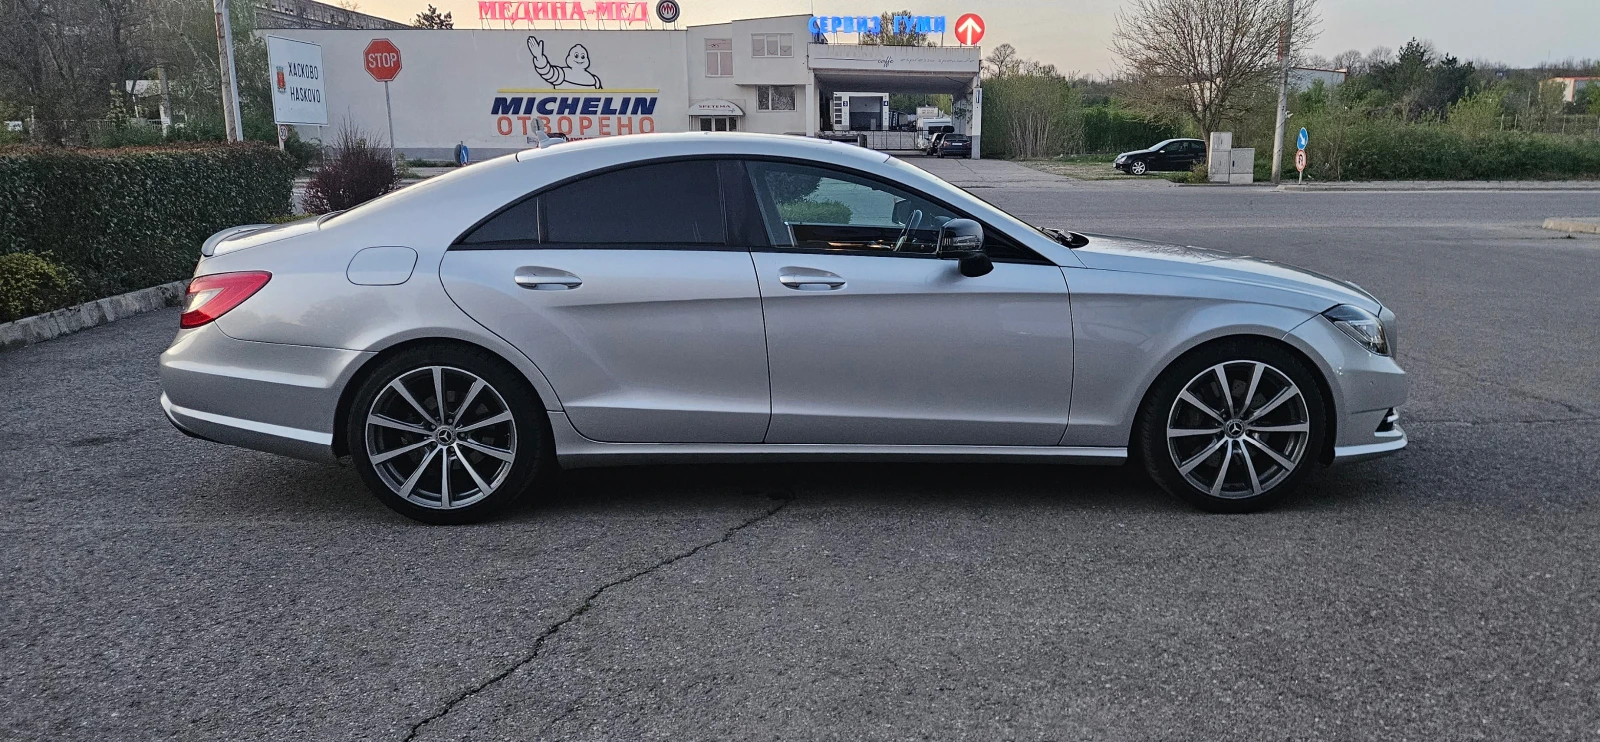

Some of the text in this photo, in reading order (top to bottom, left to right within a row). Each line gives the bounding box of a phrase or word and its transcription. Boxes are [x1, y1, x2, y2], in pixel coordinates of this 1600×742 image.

[478, 1, 648, 25] МЕДИНА-МЕД
[808, 15, 947, 34] СЕРВИЗ ГУМИ
[368, 52, 397, 68] STOP
[288, 61, 319, 80] ХАСКОВО
[290, 87, 321, 103] HASKOVO
[491, 96, 658, 115] MICHELIN
[280, 126, 287, 137] 50
